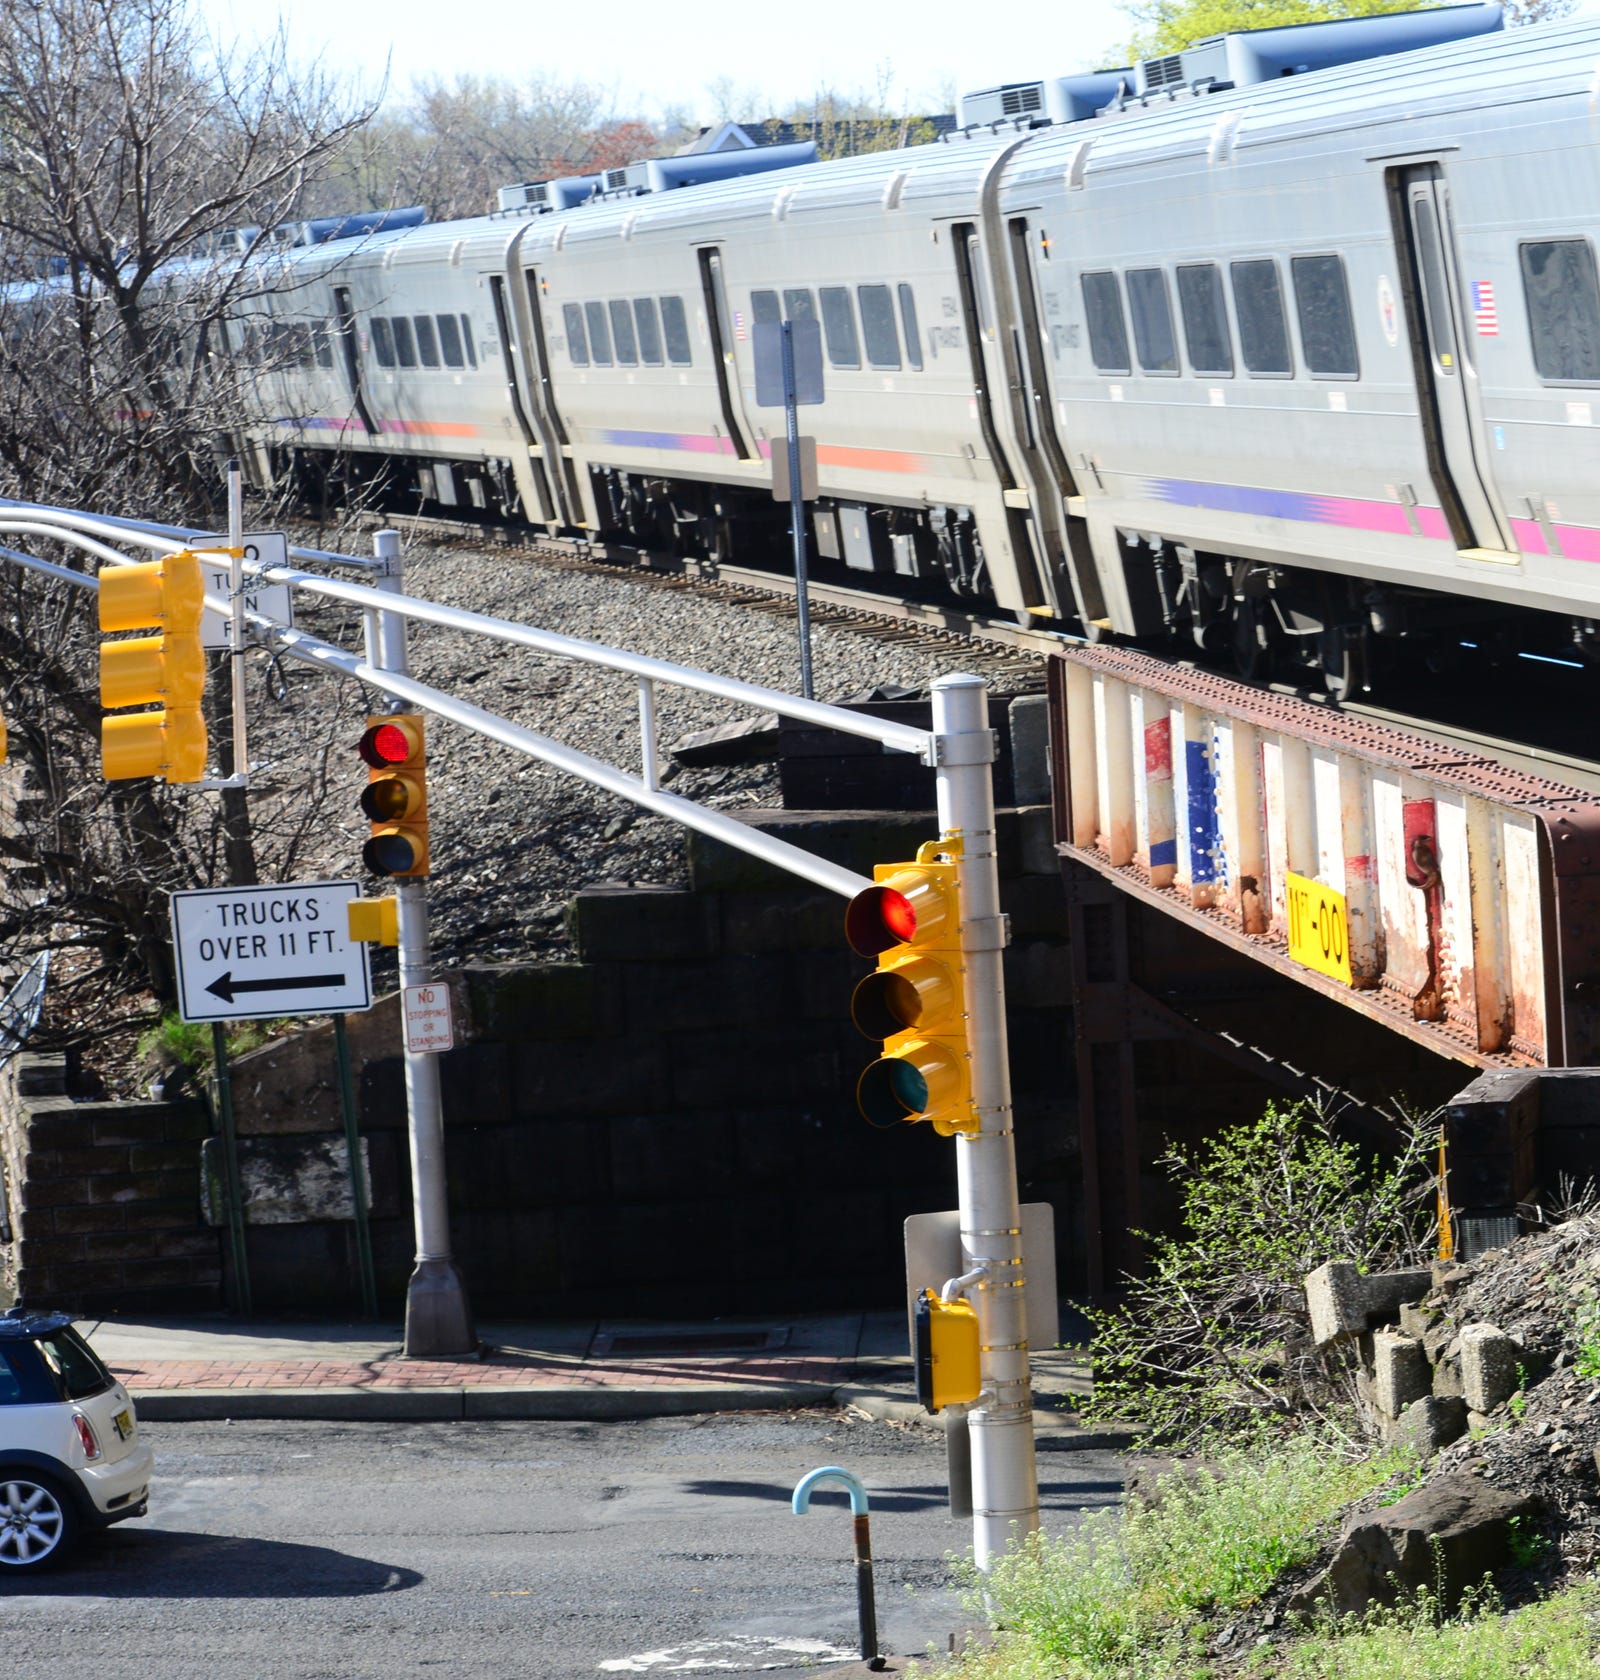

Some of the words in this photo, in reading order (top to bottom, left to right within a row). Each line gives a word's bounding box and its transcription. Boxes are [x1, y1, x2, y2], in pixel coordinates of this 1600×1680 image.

[217, 898, 320, 927] TRUCKS
[199, 934, 267, 962] OVER
[279, 932, 296, 957] 11
[308, 930, 344, 955] FT.
[417, 990, 435, 1005] NO
[408, 1008, 448, 1021] STOPPING
[422, 1023, 435, 1033] OR
[410, 1034, 449, 1047] STANDING
